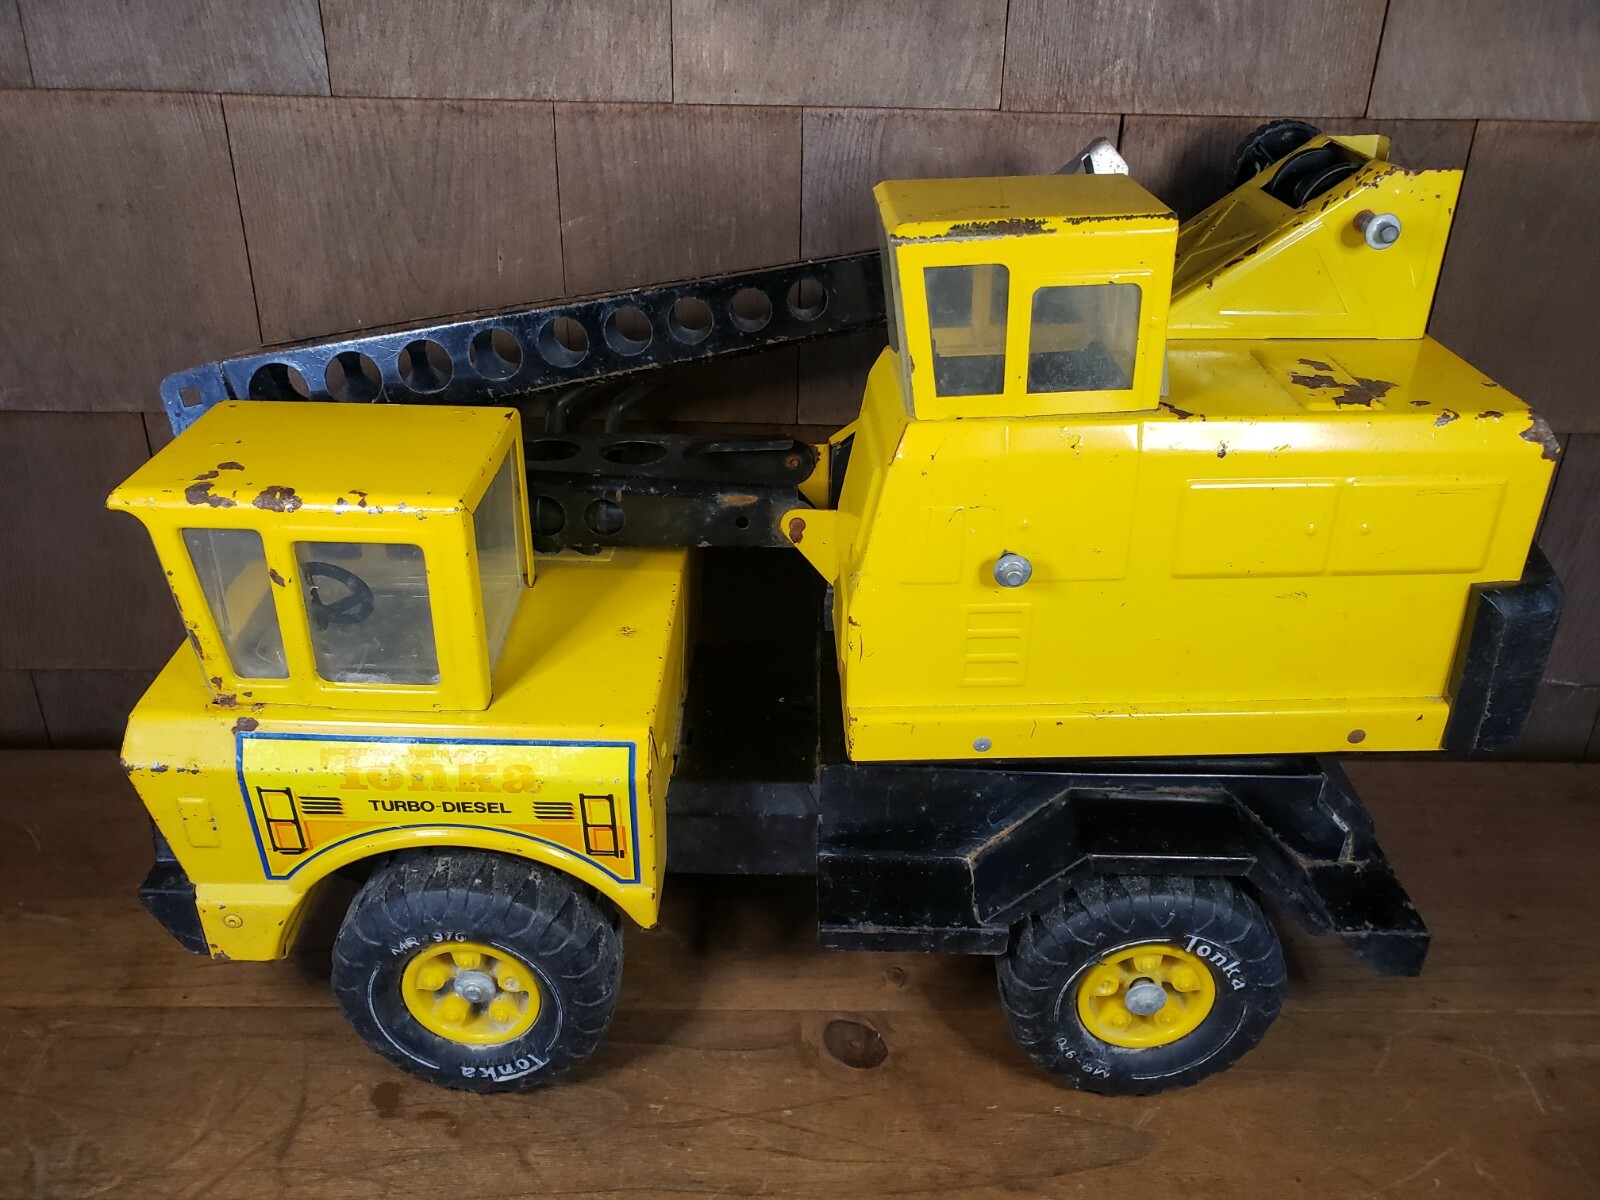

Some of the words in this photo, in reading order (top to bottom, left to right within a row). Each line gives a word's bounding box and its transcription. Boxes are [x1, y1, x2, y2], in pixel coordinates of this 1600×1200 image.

[319, 748, 542, 793] Tonka
[368, 799, 512, 814] TURBO-DIESEL
[1183, 933, 1247, 991] Tonka
[460, 1052, 550, 1083] Tonka
